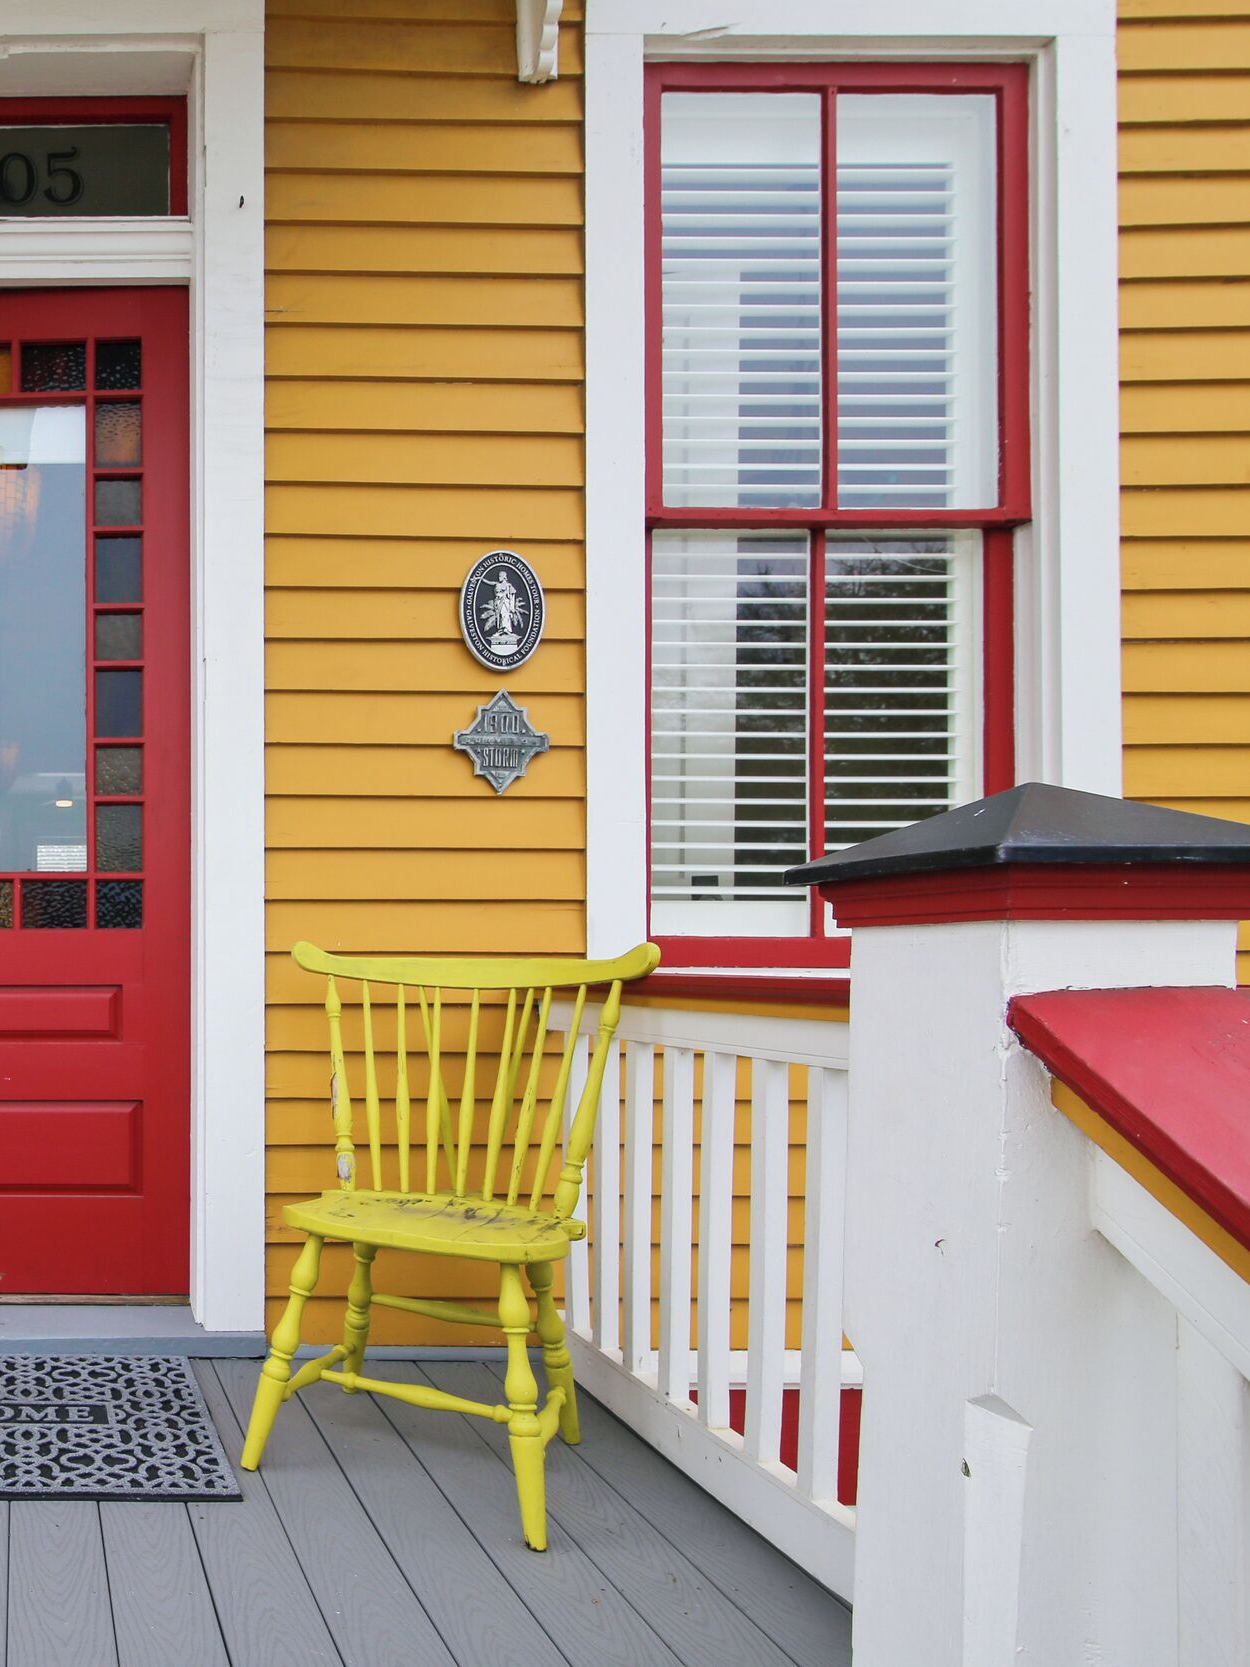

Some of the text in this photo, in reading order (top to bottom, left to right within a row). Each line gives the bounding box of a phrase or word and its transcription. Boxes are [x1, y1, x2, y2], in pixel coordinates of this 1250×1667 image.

[483, 555, 517, 568] HISTORIC
[516, 562, 534, 585] HOMES
[531, 584, 540, 605] TOUR
[466, 609, 541, 665] GALVESTON HISTORICAL FOUNDATION
[484, 714, 520, 733] 1900
[483, 747, 518, 767] STORM
